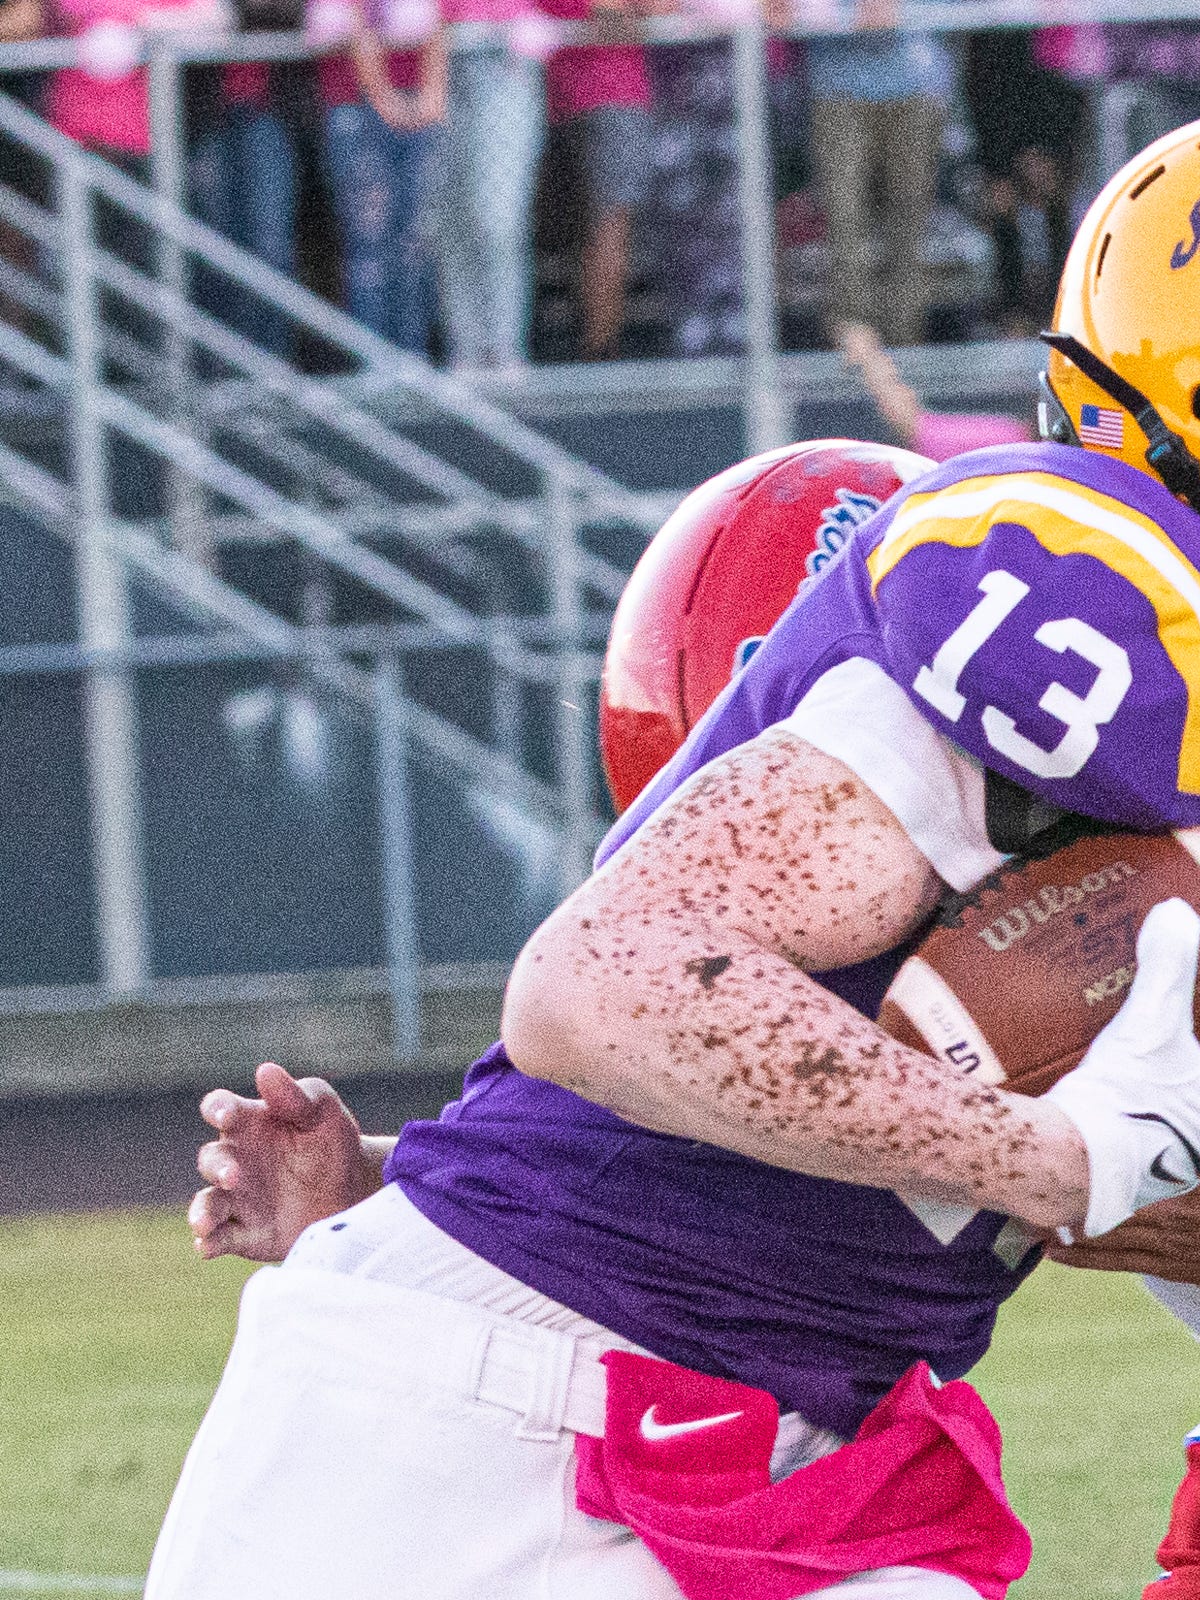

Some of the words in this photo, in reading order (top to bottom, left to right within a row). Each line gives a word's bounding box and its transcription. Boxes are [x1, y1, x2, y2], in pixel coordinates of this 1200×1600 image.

[912, 569, 1133, 778] 13
[979, 860, 1140, 952] Wilson
[1083, 964, 1137, 1007] NCA
